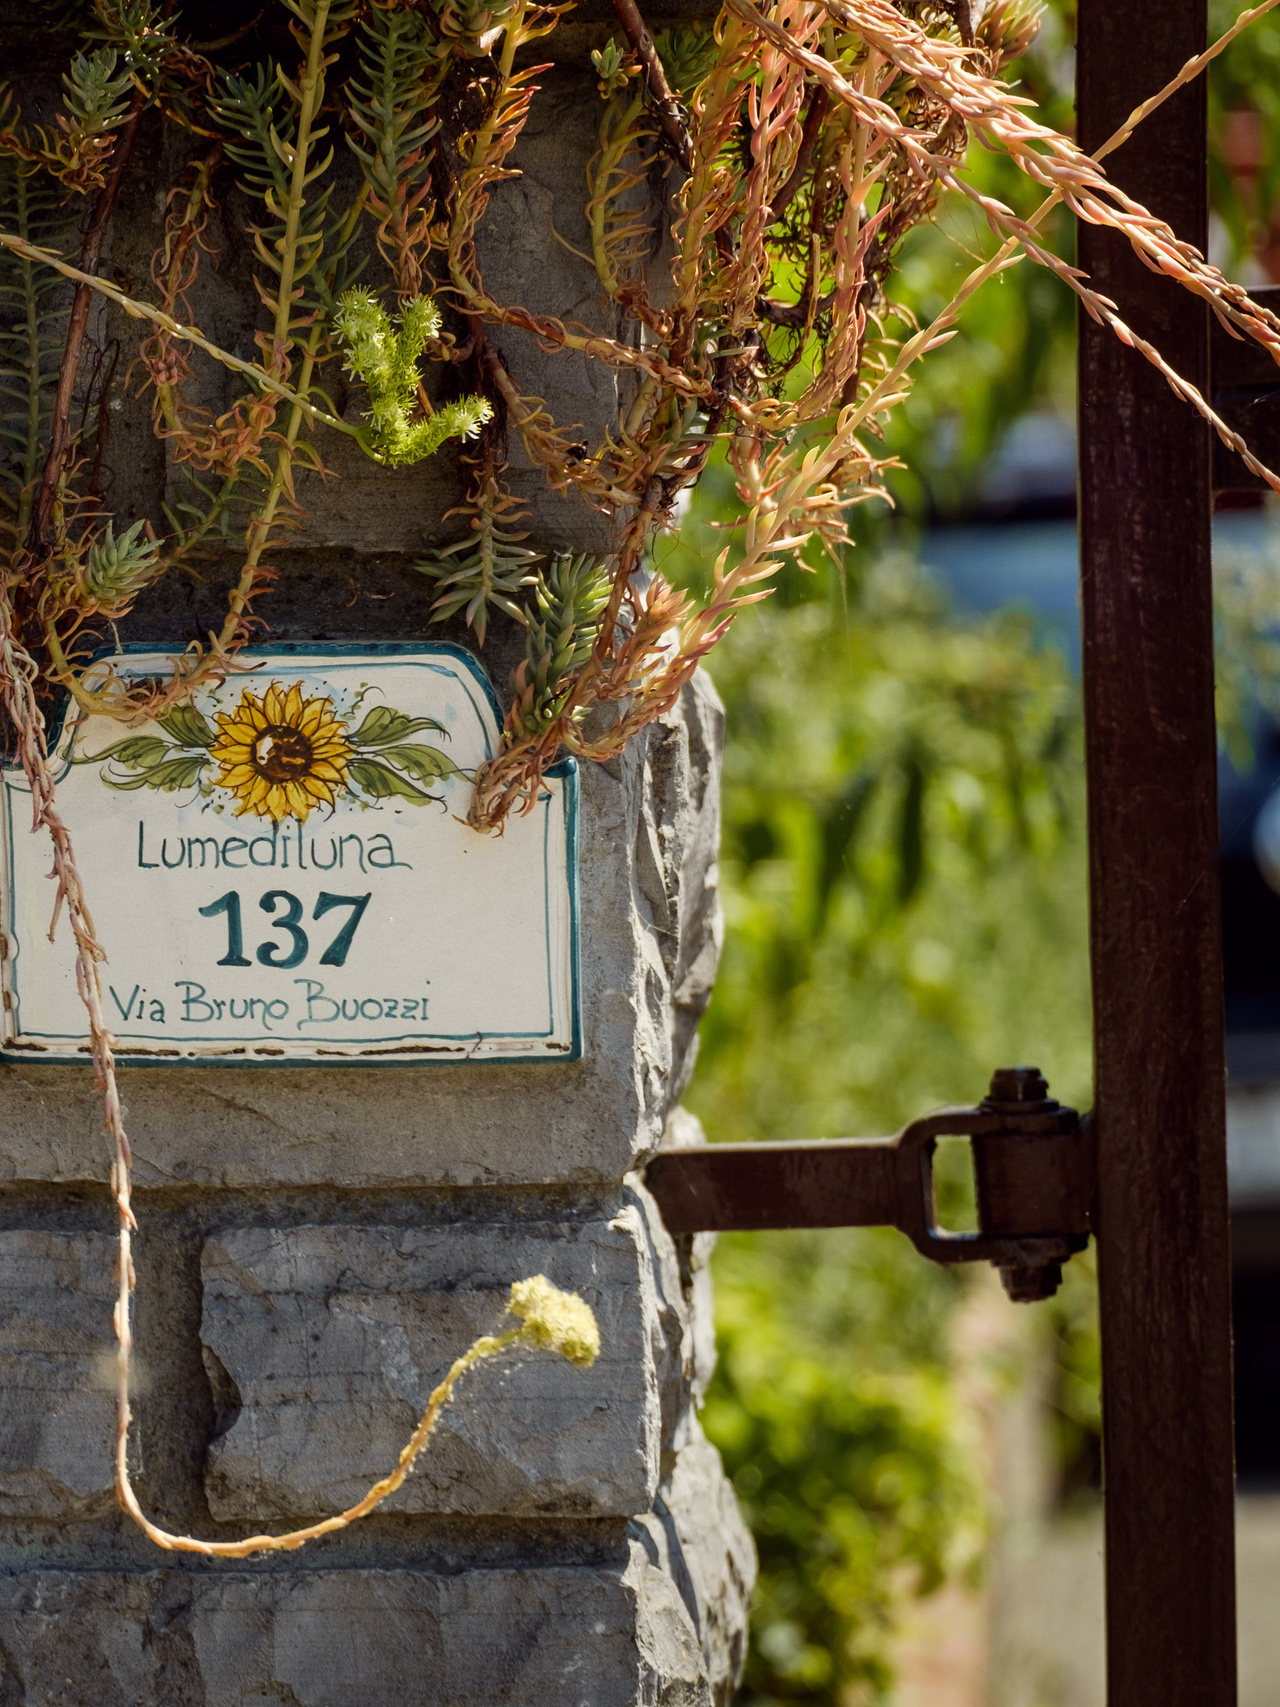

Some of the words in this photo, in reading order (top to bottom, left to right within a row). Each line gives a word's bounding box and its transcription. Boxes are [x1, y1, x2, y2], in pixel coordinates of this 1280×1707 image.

[138, 820, 413, 873] Lumediluna
[198, 890, 372, 969] 137
[108, 984, 166, 1023] Via
[175, 980, 289, 1030] Bruno
[294, 978, 431, 1030] Buozzi
